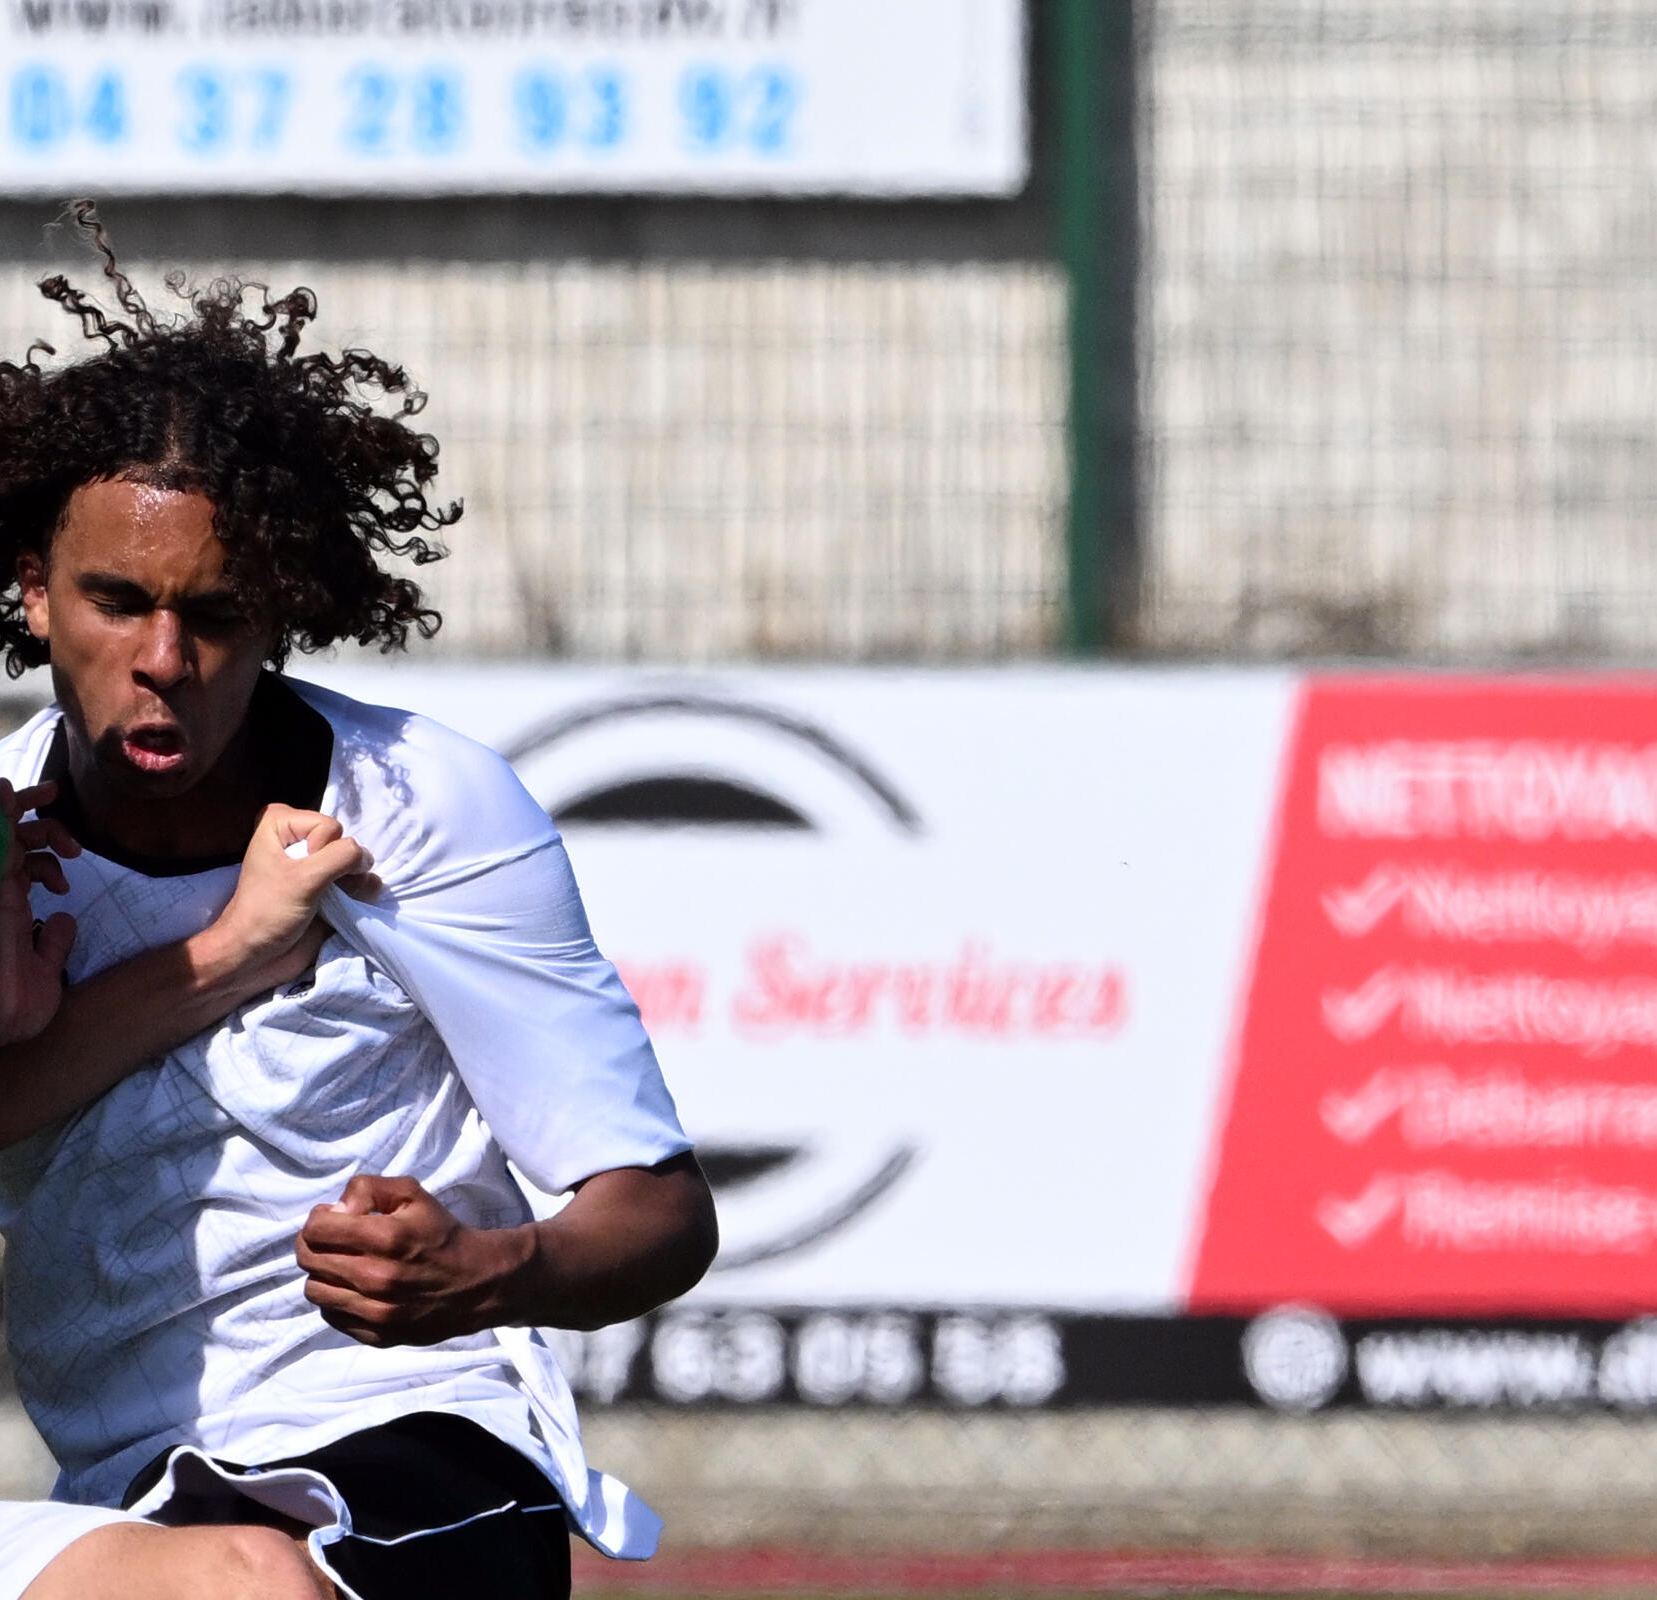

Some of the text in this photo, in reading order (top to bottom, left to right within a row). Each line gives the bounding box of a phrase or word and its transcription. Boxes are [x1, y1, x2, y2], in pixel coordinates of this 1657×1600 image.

[10, 63, 127, 154] 04
[176, 66, 291, 154] 37
[344, 65, 464, 156] 28
[679, 66, 800, 156] 92
[731, 930, 1131, 1040] Services
